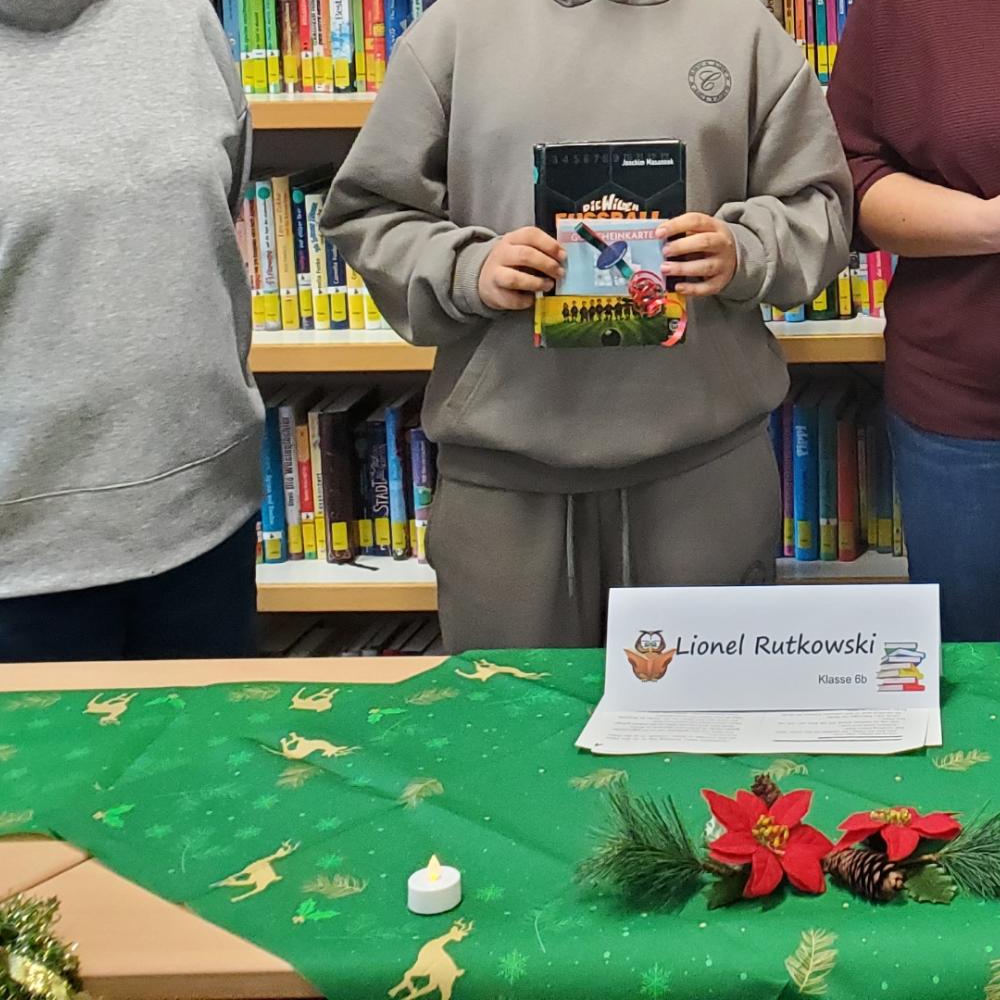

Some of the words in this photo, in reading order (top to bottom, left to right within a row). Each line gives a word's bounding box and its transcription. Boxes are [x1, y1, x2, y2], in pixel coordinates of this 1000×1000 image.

[372, 478, 389, 512] STADT
[675, 633, 746, 656] Lionel
[754, 632, 877, 656] Rutkowski
[818, 674, 852, 685] Klasse
[854, 674, 868, 685] 6b
